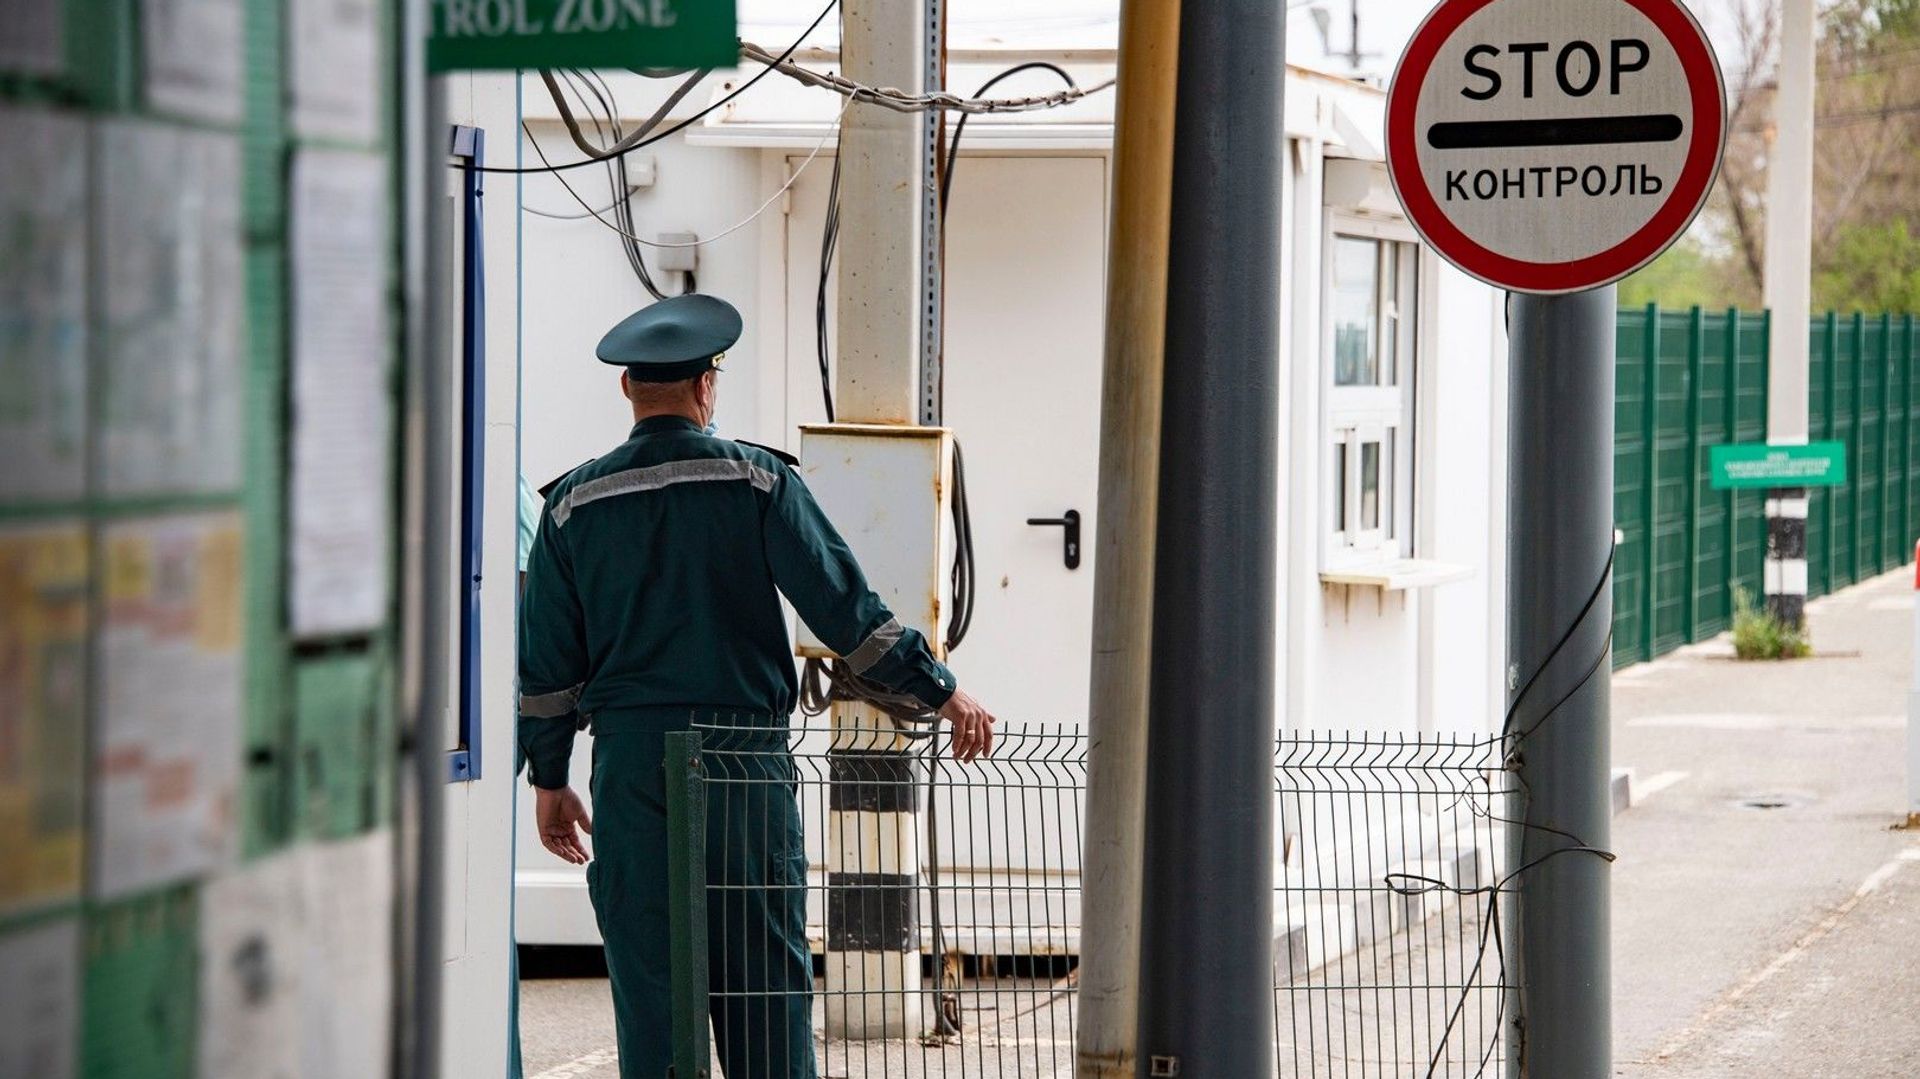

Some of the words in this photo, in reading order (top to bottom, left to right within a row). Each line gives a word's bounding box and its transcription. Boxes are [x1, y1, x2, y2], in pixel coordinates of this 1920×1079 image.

[553, 0, 678, 33] ZONE
[1460, 38, 1650, 100] STOP
[1446, 164, 1663, 201] КОНТРОЛЬ
